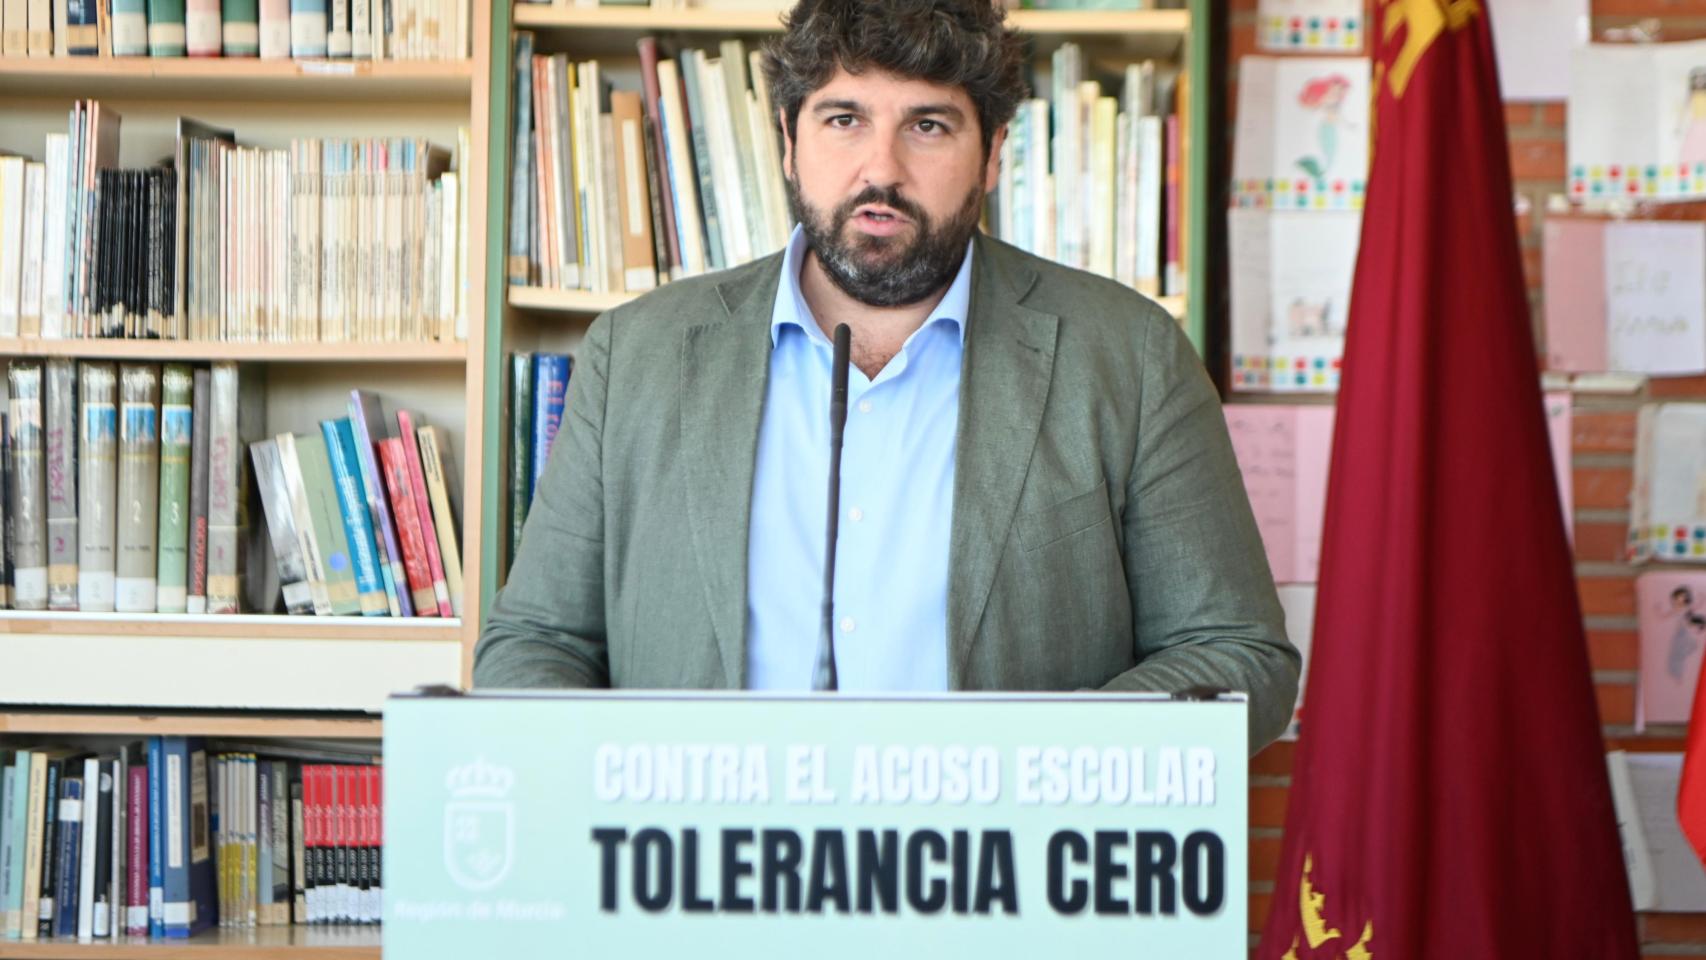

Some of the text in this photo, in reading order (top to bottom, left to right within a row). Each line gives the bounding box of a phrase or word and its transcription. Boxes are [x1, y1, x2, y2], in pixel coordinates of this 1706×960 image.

[594, 743, 1216, 806] CONTRA EL ACOSO ESCOLAR
[591, 827, 1225, 916] TOLERANCIA CERO
